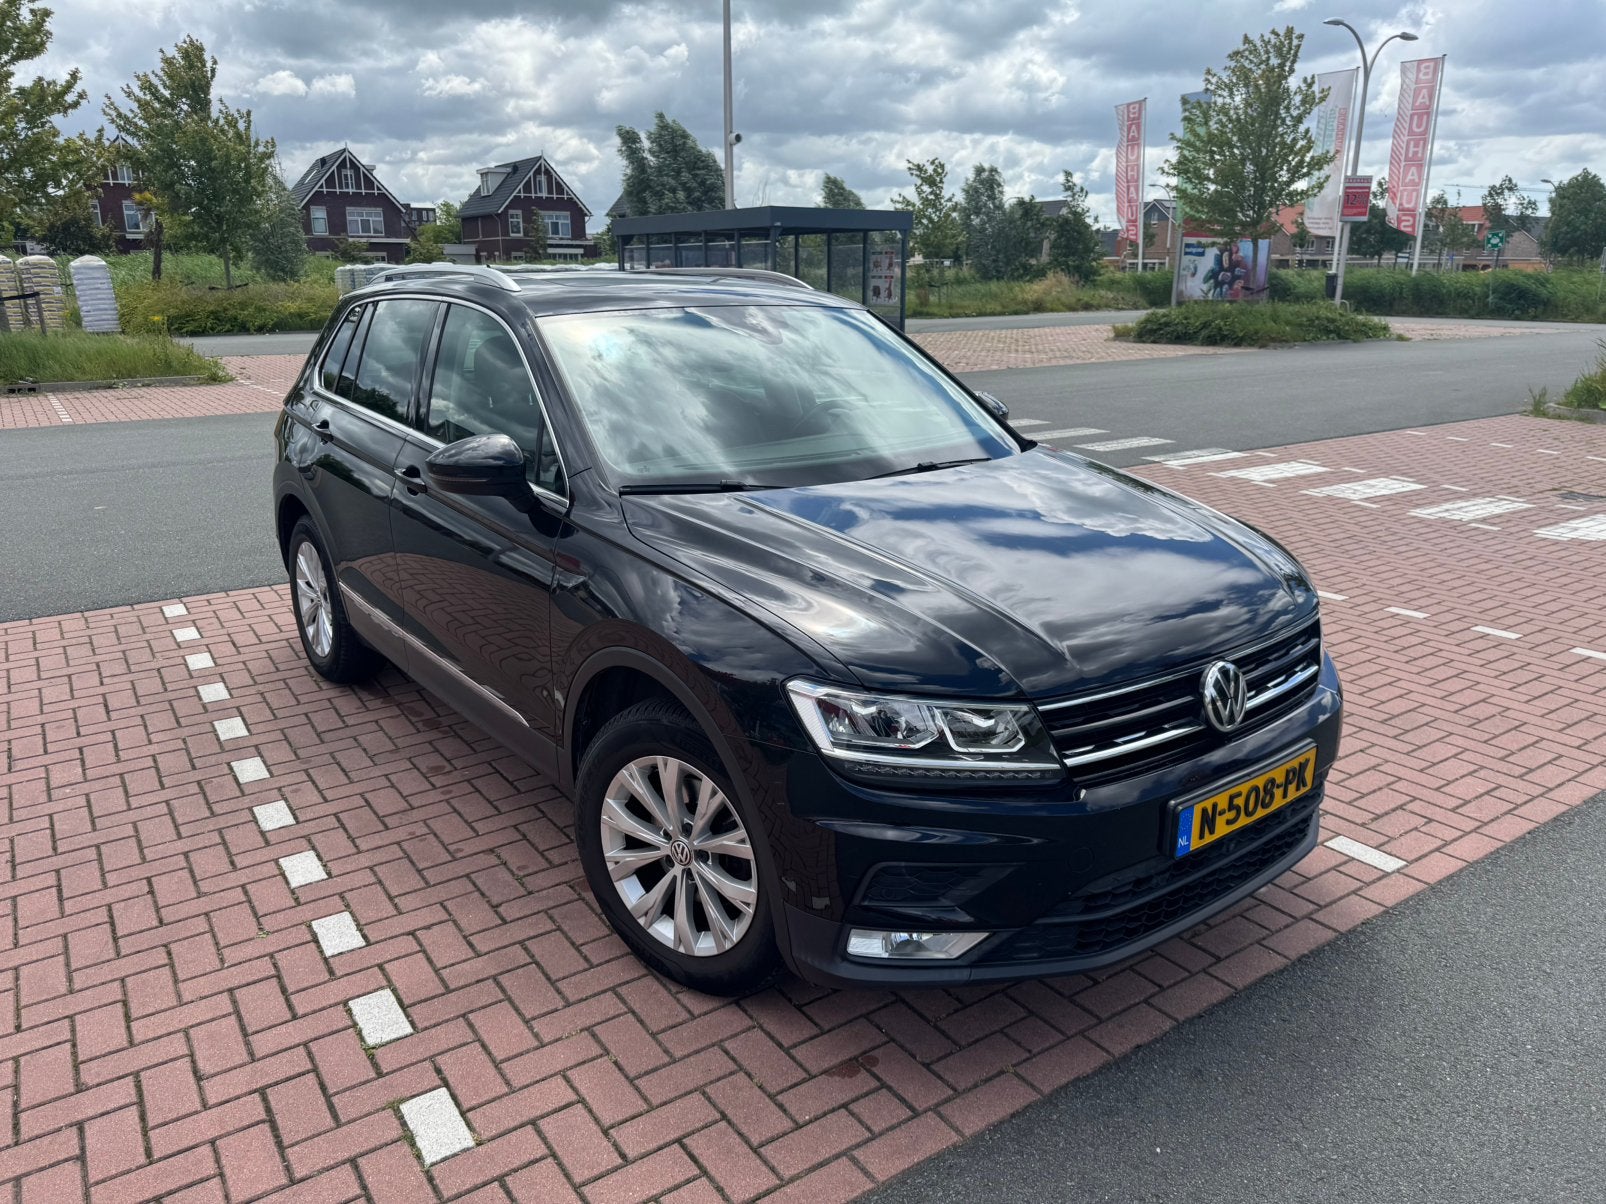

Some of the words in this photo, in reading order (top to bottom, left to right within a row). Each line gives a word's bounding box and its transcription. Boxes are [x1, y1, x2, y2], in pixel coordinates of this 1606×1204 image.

[1346, 194, 1368, 208] 12%
[1198, 758, 1310, 841] N-508-PK
[1178, 836, 1189, 847] NL
